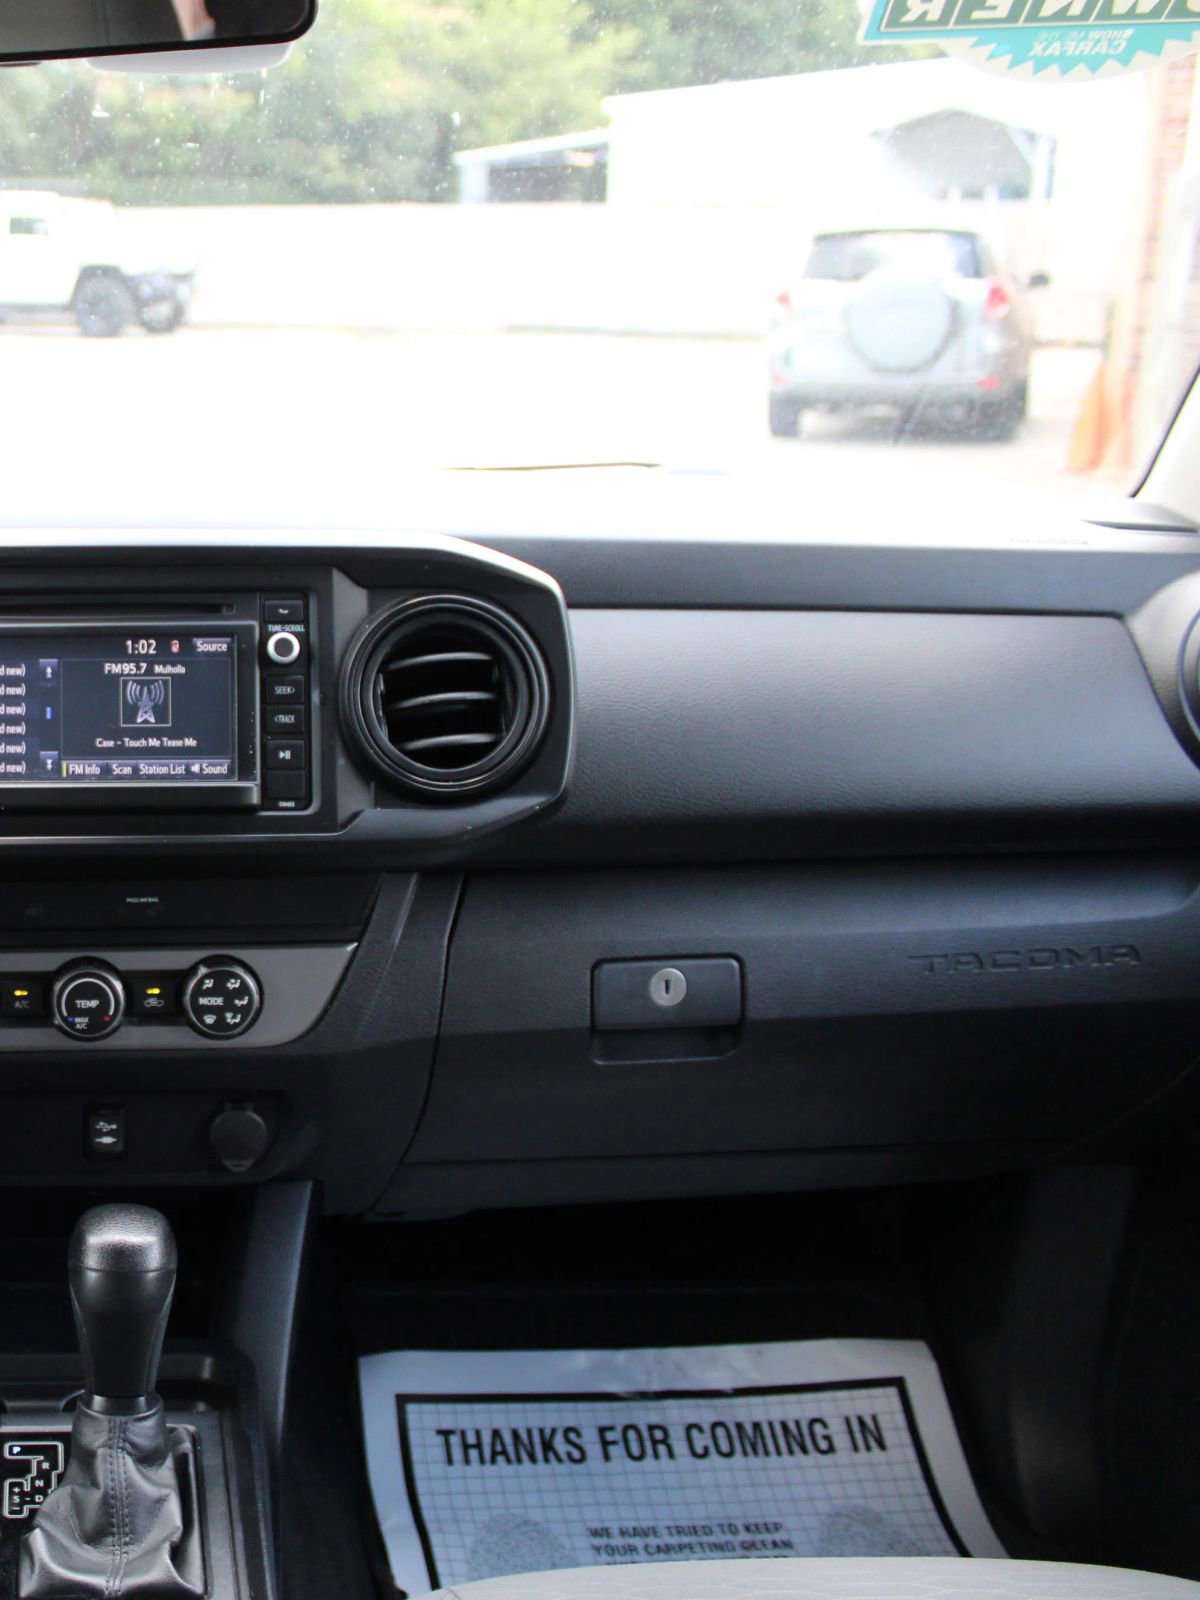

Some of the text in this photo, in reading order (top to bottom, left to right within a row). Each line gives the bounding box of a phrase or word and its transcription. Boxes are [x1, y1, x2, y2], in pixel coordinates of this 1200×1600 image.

[125, 639, 157, 655] 1:02
[196, 641, 228, 652] Source
[6, 664, 26, 677] new)
[154, 664, 186, 674] Mulholla
[6, 684, 26, 696] new)
[6, 703, 26, 716] new)
[6, 722, 26, 736] new)
[6, 742, 26, 755] new)
[95, 738, 115, 748] Case
[124, 738, 146, 748] Touch
[148, 738, 161, 748] Me
[163, 738, 183, 748] Tease
[185, 738, 197, 748] Me
[6, 762, 26, 774] new)
[68, 764, 101, 775] FM Info
[112, 764, 132, 775] Scan
[139, 763, 186, 775] Station List
[202, 763, 228, 775] Sound
[909, 944, 1141, 975] TACOMA
[14, 1001, 29, 1009] A/C
[75, 1000, 99, 1008] TEMP
[198, 997, 224, 1006] MODE
[436, 1413, 888, 1467] THANKS FOR COMING IN
[587, 1522, 783, 1539] WE HAVE TRIED TO KEEP
[591, 1539, 794, 1557] YOUR CARPETING CLEAN
